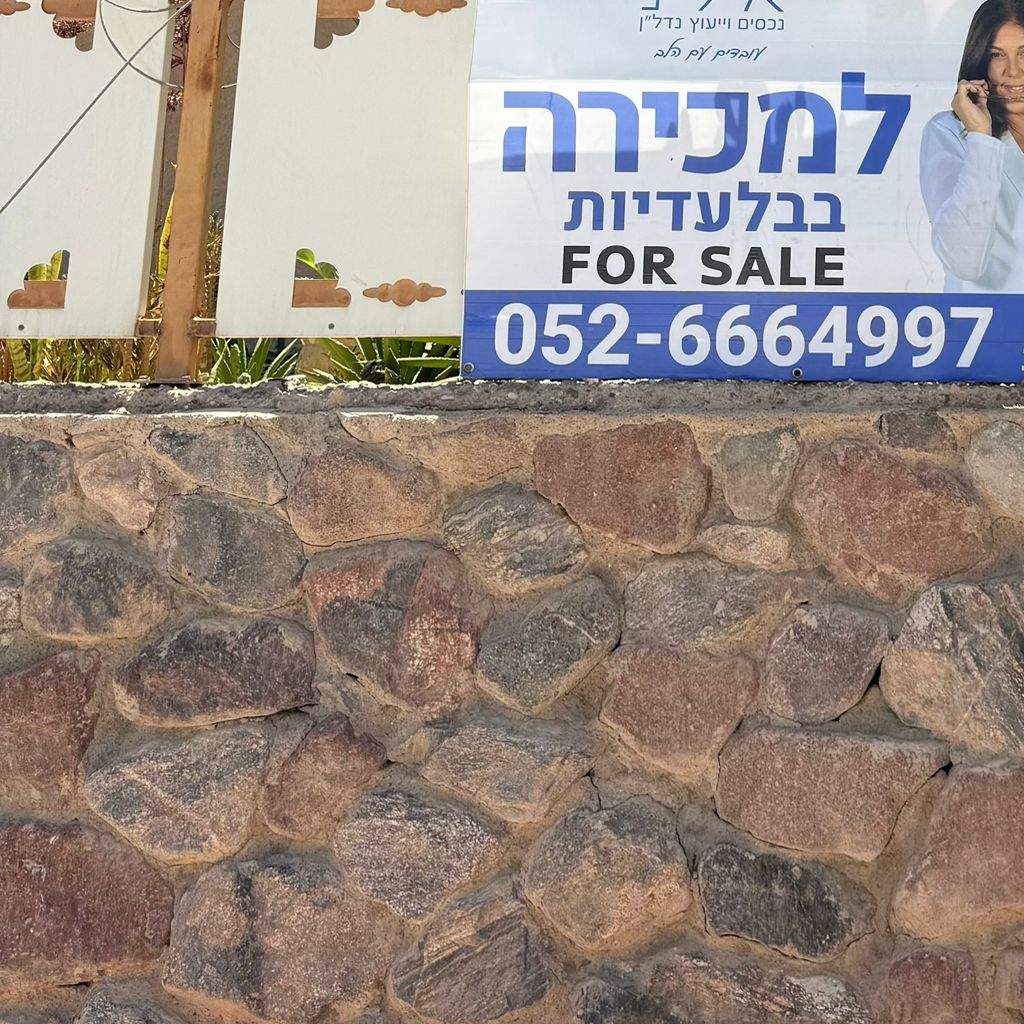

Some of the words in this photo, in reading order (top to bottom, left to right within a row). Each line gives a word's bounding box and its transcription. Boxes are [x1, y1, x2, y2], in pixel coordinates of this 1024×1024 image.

[689, 16, 731, 33] וייעוץ
[737, 17, 785, 31] נכסים
[653, 37, 685, 59] הלב
[684, 45, 712, 62] עם
[711, 45, 767, 62] עובדים
[502, 72, 912, 175] למכירה
[563, 181, 846, 233] בבלעדיות
[562, 245, 677, 285] FOR
[700, 246, 846, 286] SALE
[493, 302, 994, 369] 052-6664997
